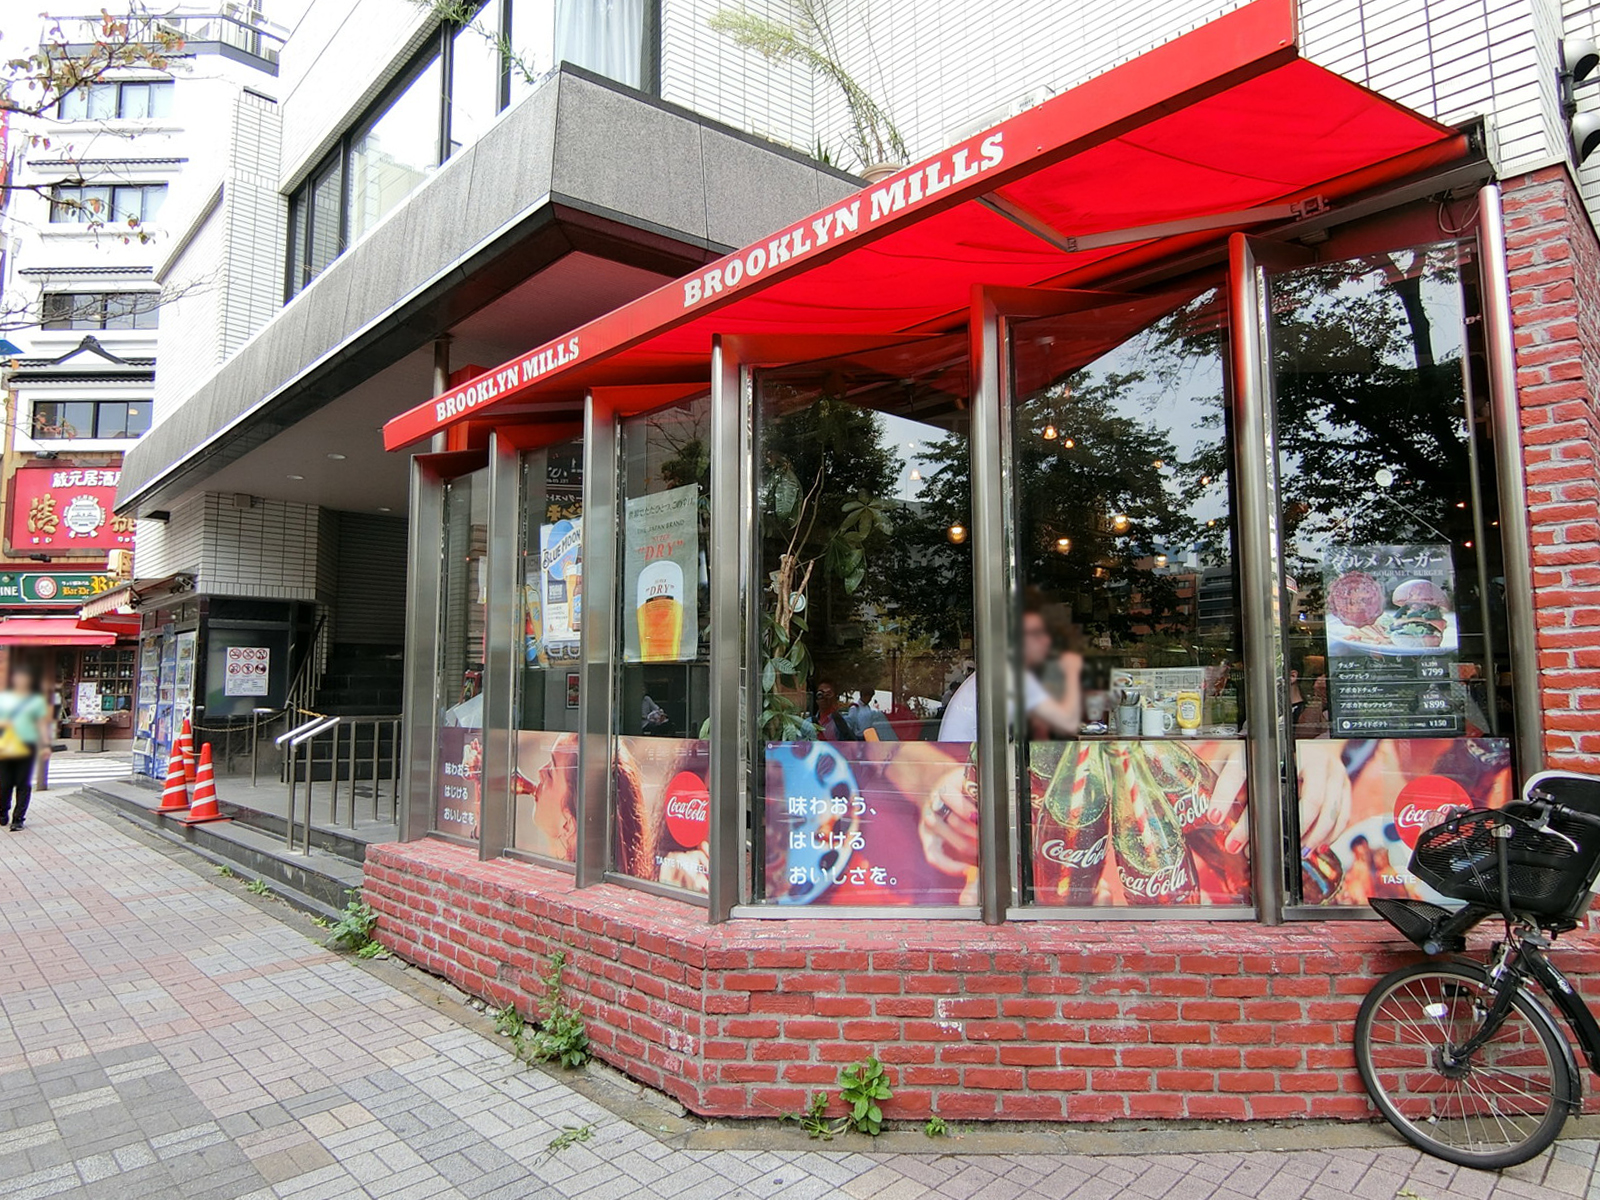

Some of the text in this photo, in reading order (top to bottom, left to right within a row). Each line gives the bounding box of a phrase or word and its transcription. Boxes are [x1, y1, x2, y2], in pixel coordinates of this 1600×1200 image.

[684, 132, 1004, 308] BROOKLYN MILLS
[435, 336, 580, 422] BROOKLYN MILLS
[543, 544, 562, 569] BLUE
[1331, 552, 1442, 569] グルメ バーガー
[1413, 568, 1444, 576] BURGER
[1421, 668, 1444, 676] ¥799
[1423, 700, 1445, 708] ¥899
[444, 785, 468, 800] はじける
[667, 796, 709, 821] Coca-Cola
[788, 796, 878, 816] 味わおう、
[789, 831, 866, 850] はじける
[788, 866, 897, 885] おいしさを。
[1381, 874, 1417, 885] TASTE
